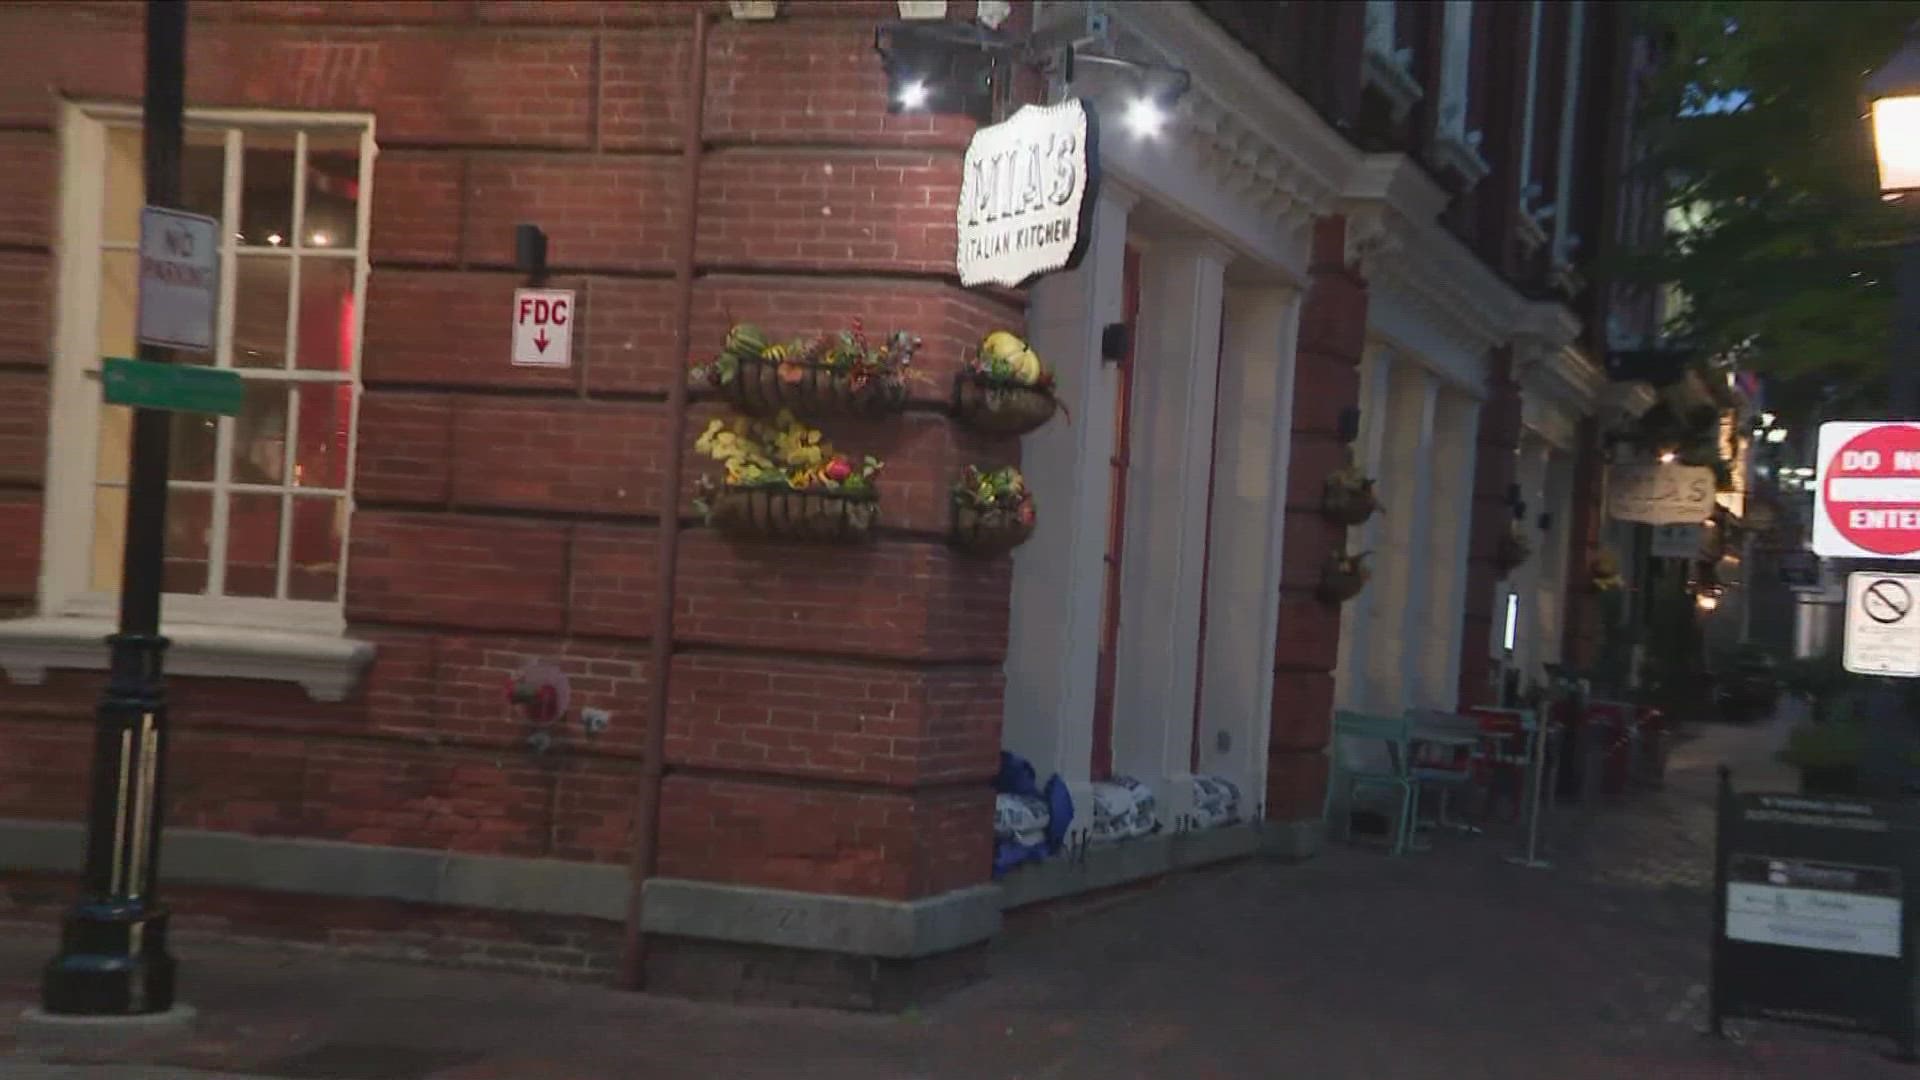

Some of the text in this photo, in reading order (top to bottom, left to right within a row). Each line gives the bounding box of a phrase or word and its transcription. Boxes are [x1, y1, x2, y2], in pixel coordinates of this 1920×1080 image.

[967, 131, 1076, 226] MIA'S
[966, 218, 1071, 261] ITALIAN KITCHEN
[519, 299, 567, 325] FDC
[1842, 450, 1881, 471] DO
[1850, 509, 1920, 530] ENTE
